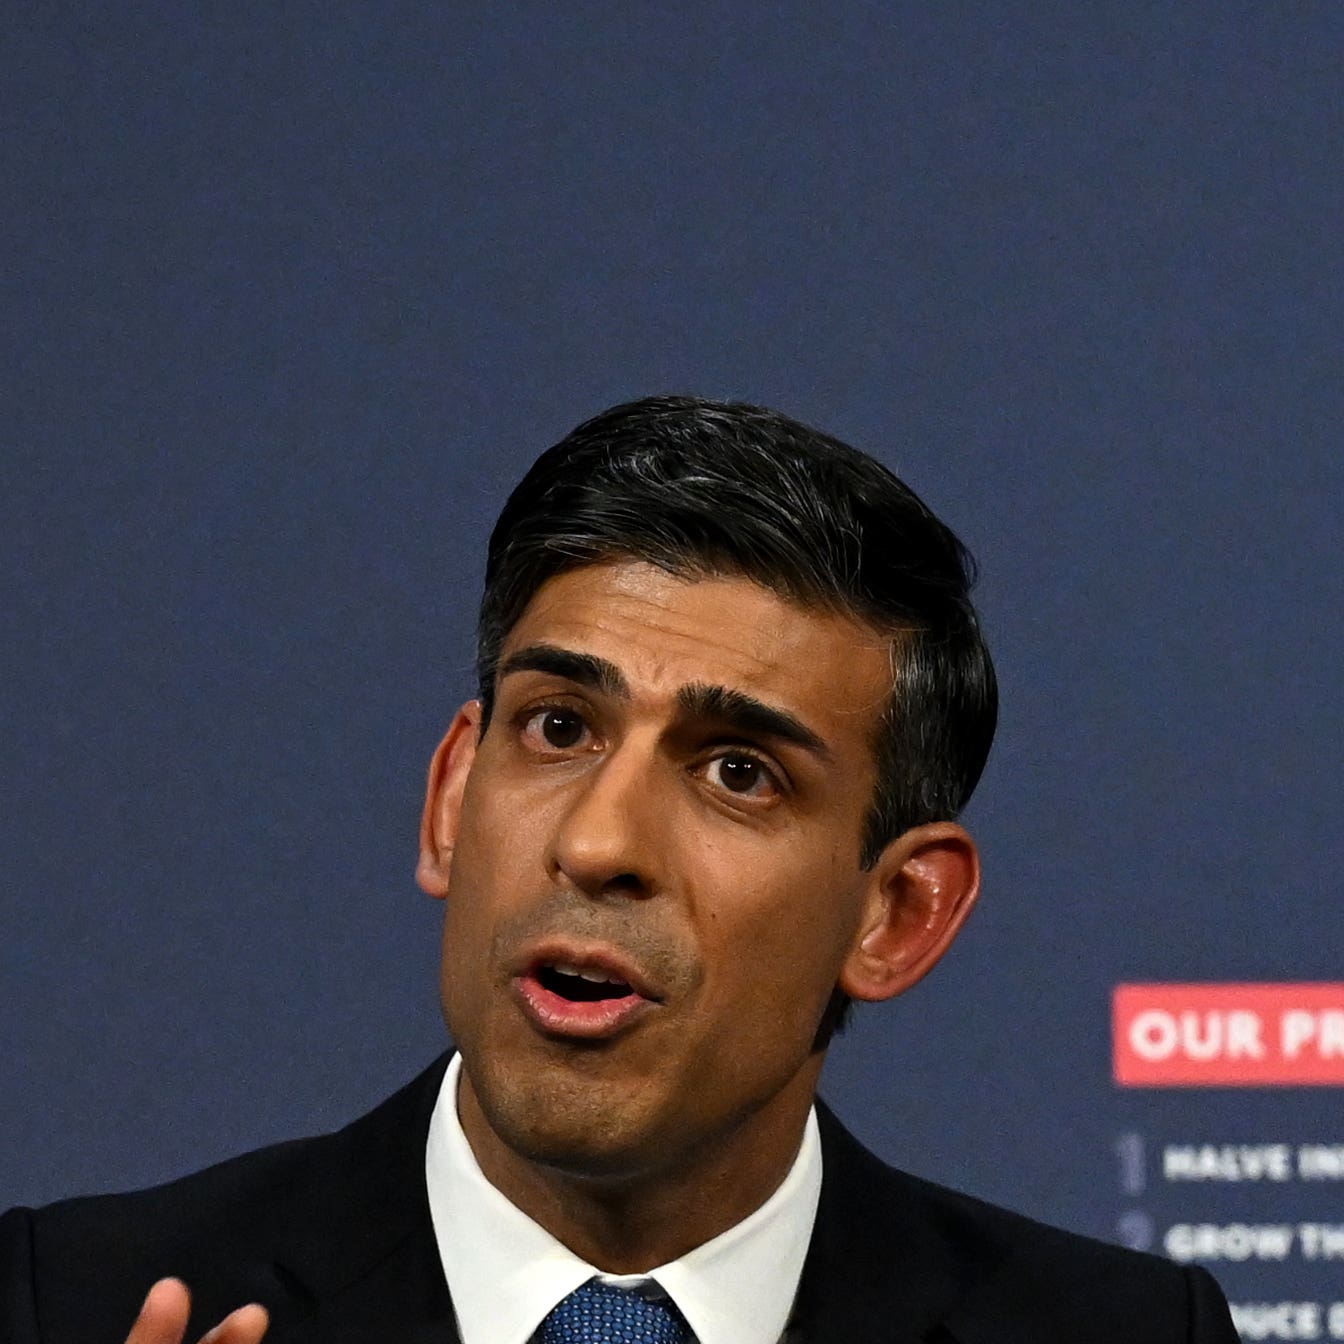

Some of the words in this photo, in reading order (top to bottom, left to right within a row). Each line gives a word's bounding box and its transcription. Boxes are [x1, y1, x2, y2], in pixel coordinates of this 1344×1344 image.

[1128, 1009, 1266, 1060] OUR
[1163, 1144, 1290, 1181] HALVE
[1164, 1224, 1293, 1261] GROW
